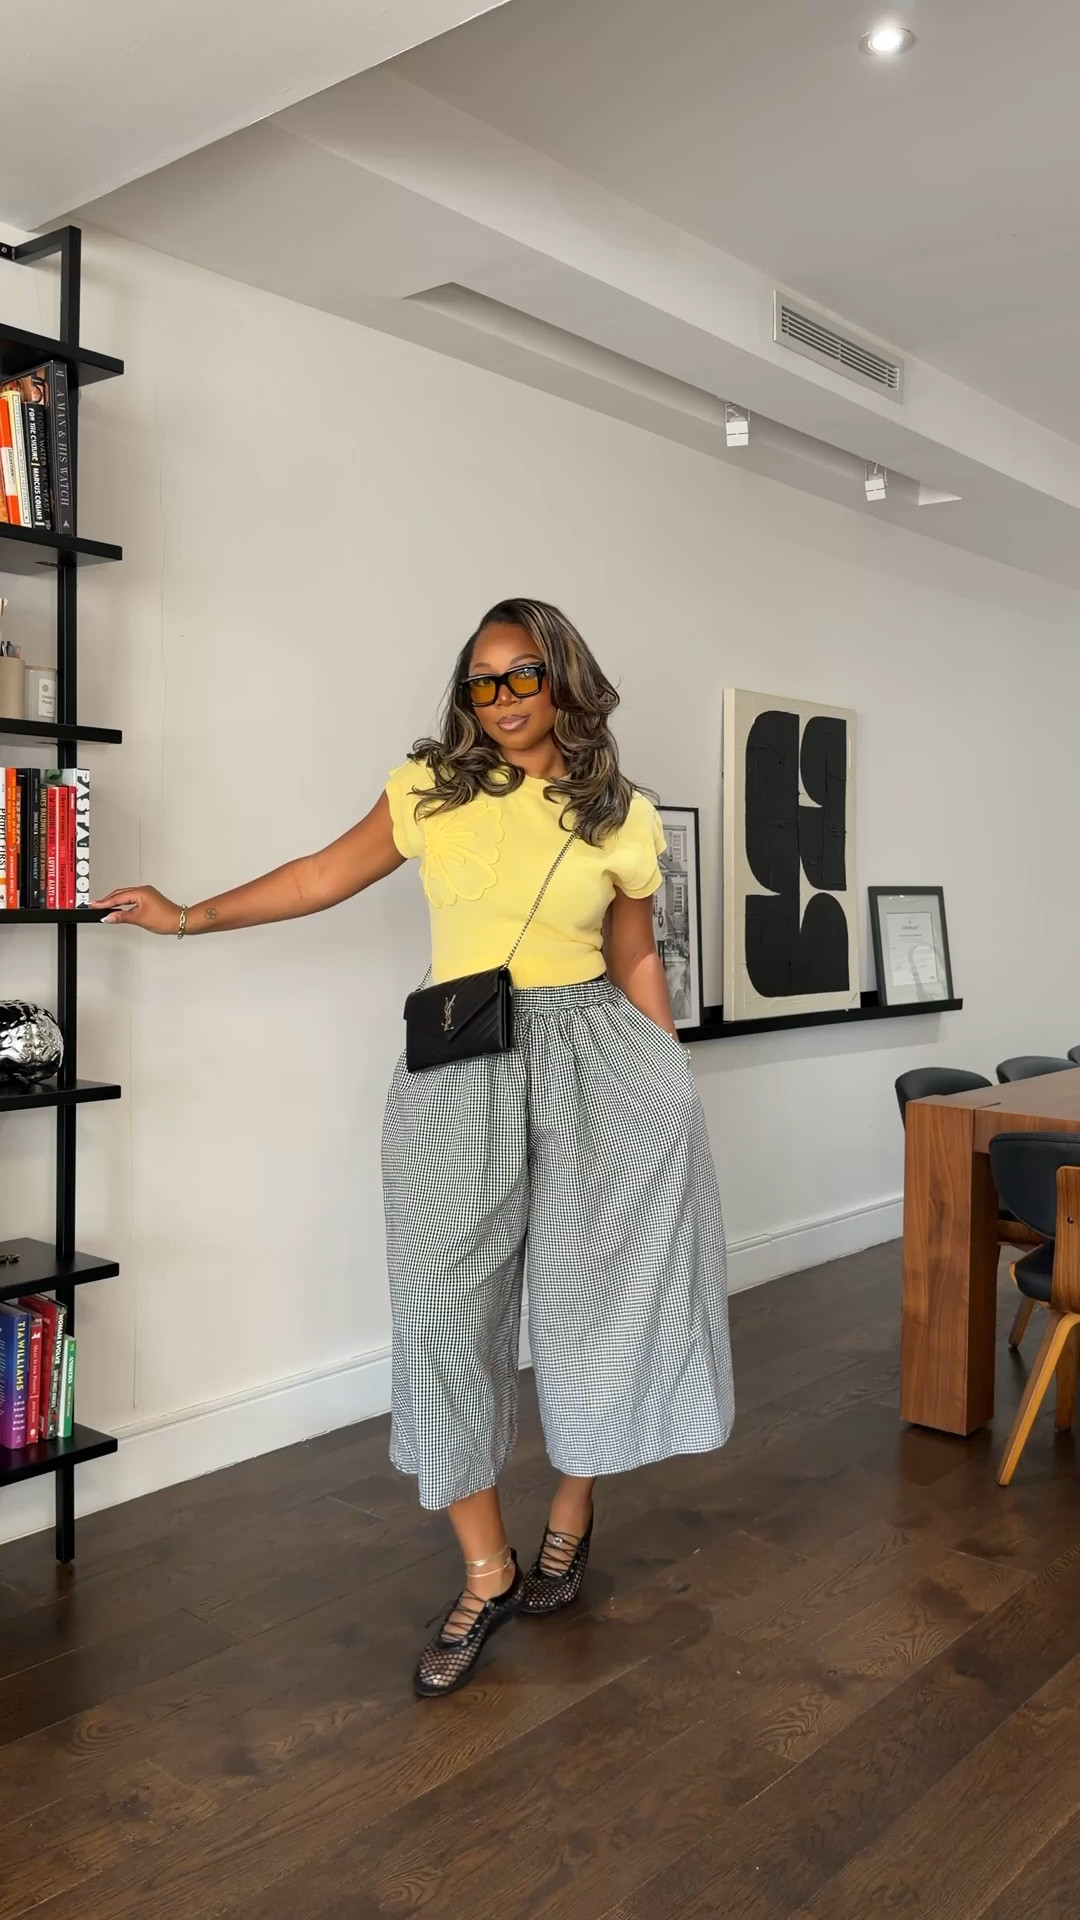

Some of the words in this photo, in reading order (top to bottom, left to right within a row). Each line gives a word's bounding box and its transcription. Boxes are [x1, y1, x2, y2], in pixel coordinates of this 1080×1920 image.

[58, 402, 66, 428] MAN
[58, 444, 68, 462] HIS
[60, 468, 70, 506] WATCH
[77, 769, 89, 842] PASTA
[76, 846, 89, 908] BOOK
[440, 994, 457, 1032] YSL
[17, 1321, 25, 1339] TIA
[16, 1340, 25, 1390] WILLIAMS
